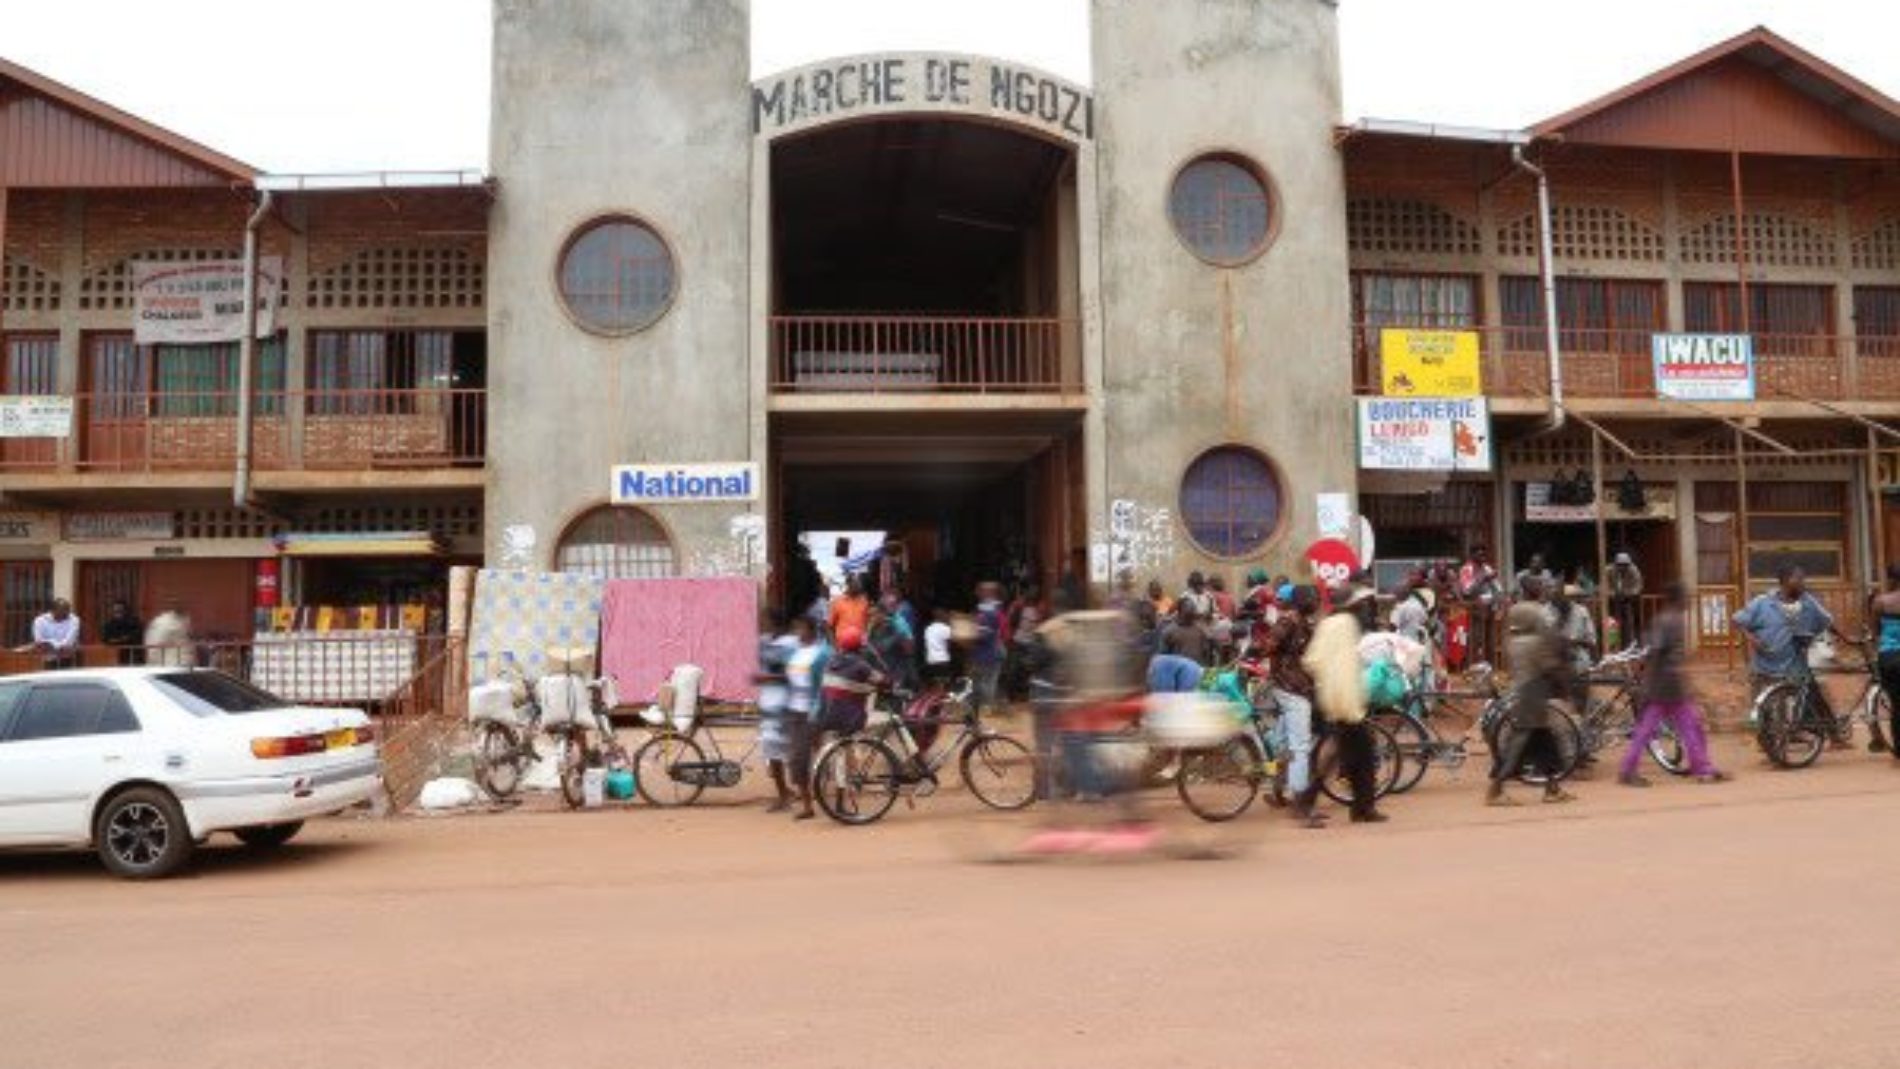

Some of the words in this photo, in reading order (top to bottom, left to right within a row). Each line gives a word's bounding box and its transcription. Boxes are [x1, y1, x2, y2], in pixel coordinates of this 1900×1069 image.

[751, 59, 906, 133] MARCHE
[925, 59, 970, 104] DE
[990, 65, 1095, 139] NGOZI
[1661, 336, 1746, 364] IWACU
[1367, 399, 1477, 421] BOUCHERIE
[620, 469, 751, 498] National
